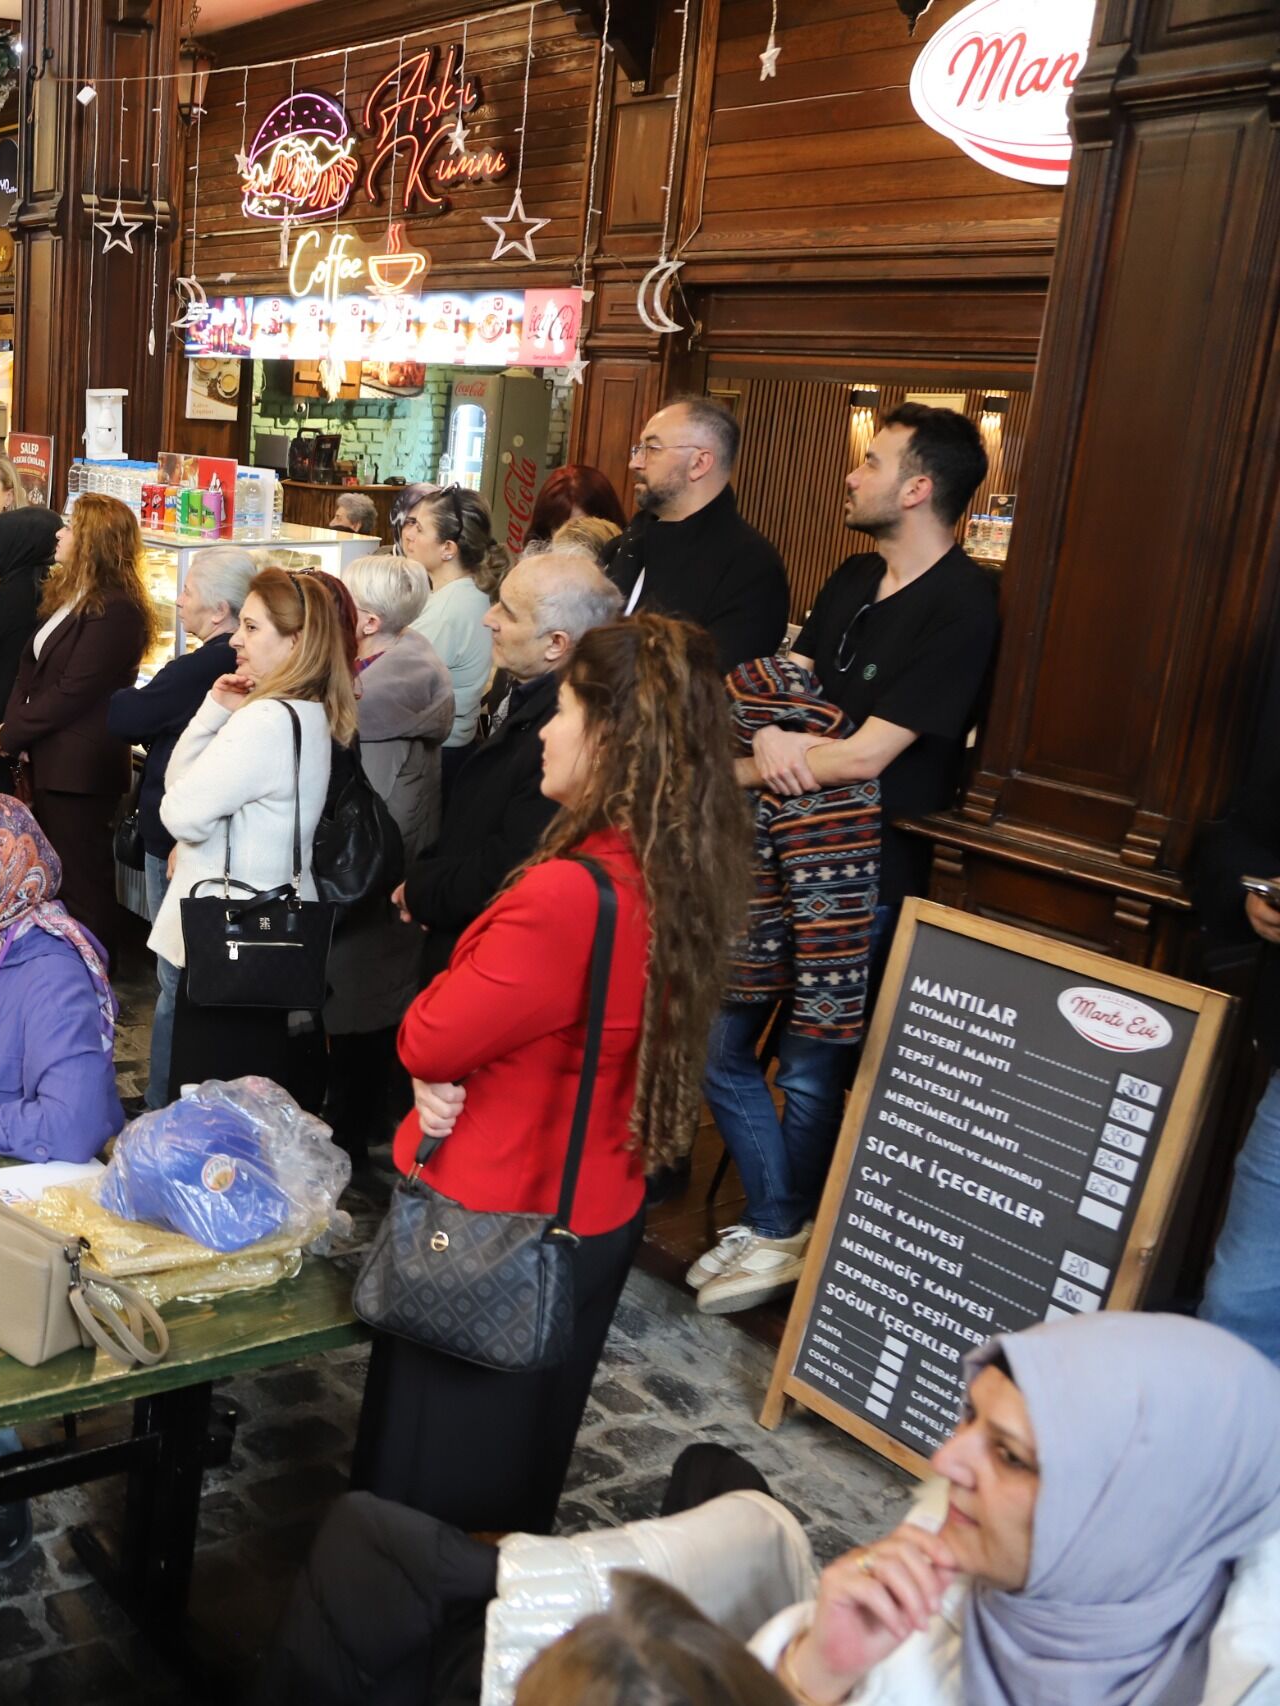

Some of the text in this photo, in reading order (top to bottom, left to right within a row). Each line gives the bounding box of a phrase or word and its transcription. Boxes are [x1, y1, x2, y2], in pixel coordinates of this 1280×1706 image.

[948, 32, 1079, 107] Man
[368, 122, 507, 208] Kumru
[288, 229, 366, 308] Coffee
[20, 442, 40, 456] SALEP
[909, 1001, 1017, 1049] KIYMALI MANTI
[910, 975, 1018, 1027] MANTILAR
[1126, 1017, 1160, 1039] Evi
[898, 1045, 984, 1087] TEPSİ MANTI
[902, 1023, 1012, 1073] KAYSERİ MANTI
[884, 1089, 1020, 1153] MERCİMEKLİ MANTI
[890, 1067, 1011, 1123] PATATESLİ MANTI
[860, 1166, 893, 1187] ÇAY
[878, 1110, 1043, 1190] BÖREK (TAVUK VE MANTARLI)
[866, 1135, 1046, 1228] SICAK İÇECEKLER
[847, 1212, 963, 1279] DİBEK KAHVESİ
[854, 1188, 965, 1251] TÜRK KAHVESİ
[834, 1259, 909, 1307] EXPRESSO
[840, 1236, 994, 1322] MENENGİÇ KAHVESİ
[816, 1319, 843, 1339] FANTA
[825, 1282, 960, 1364] SOĞUK İÇECEKLER
[808, 1348, 854, 1380] COCA COLA
[900, 1420, 925, 1439] SADE
